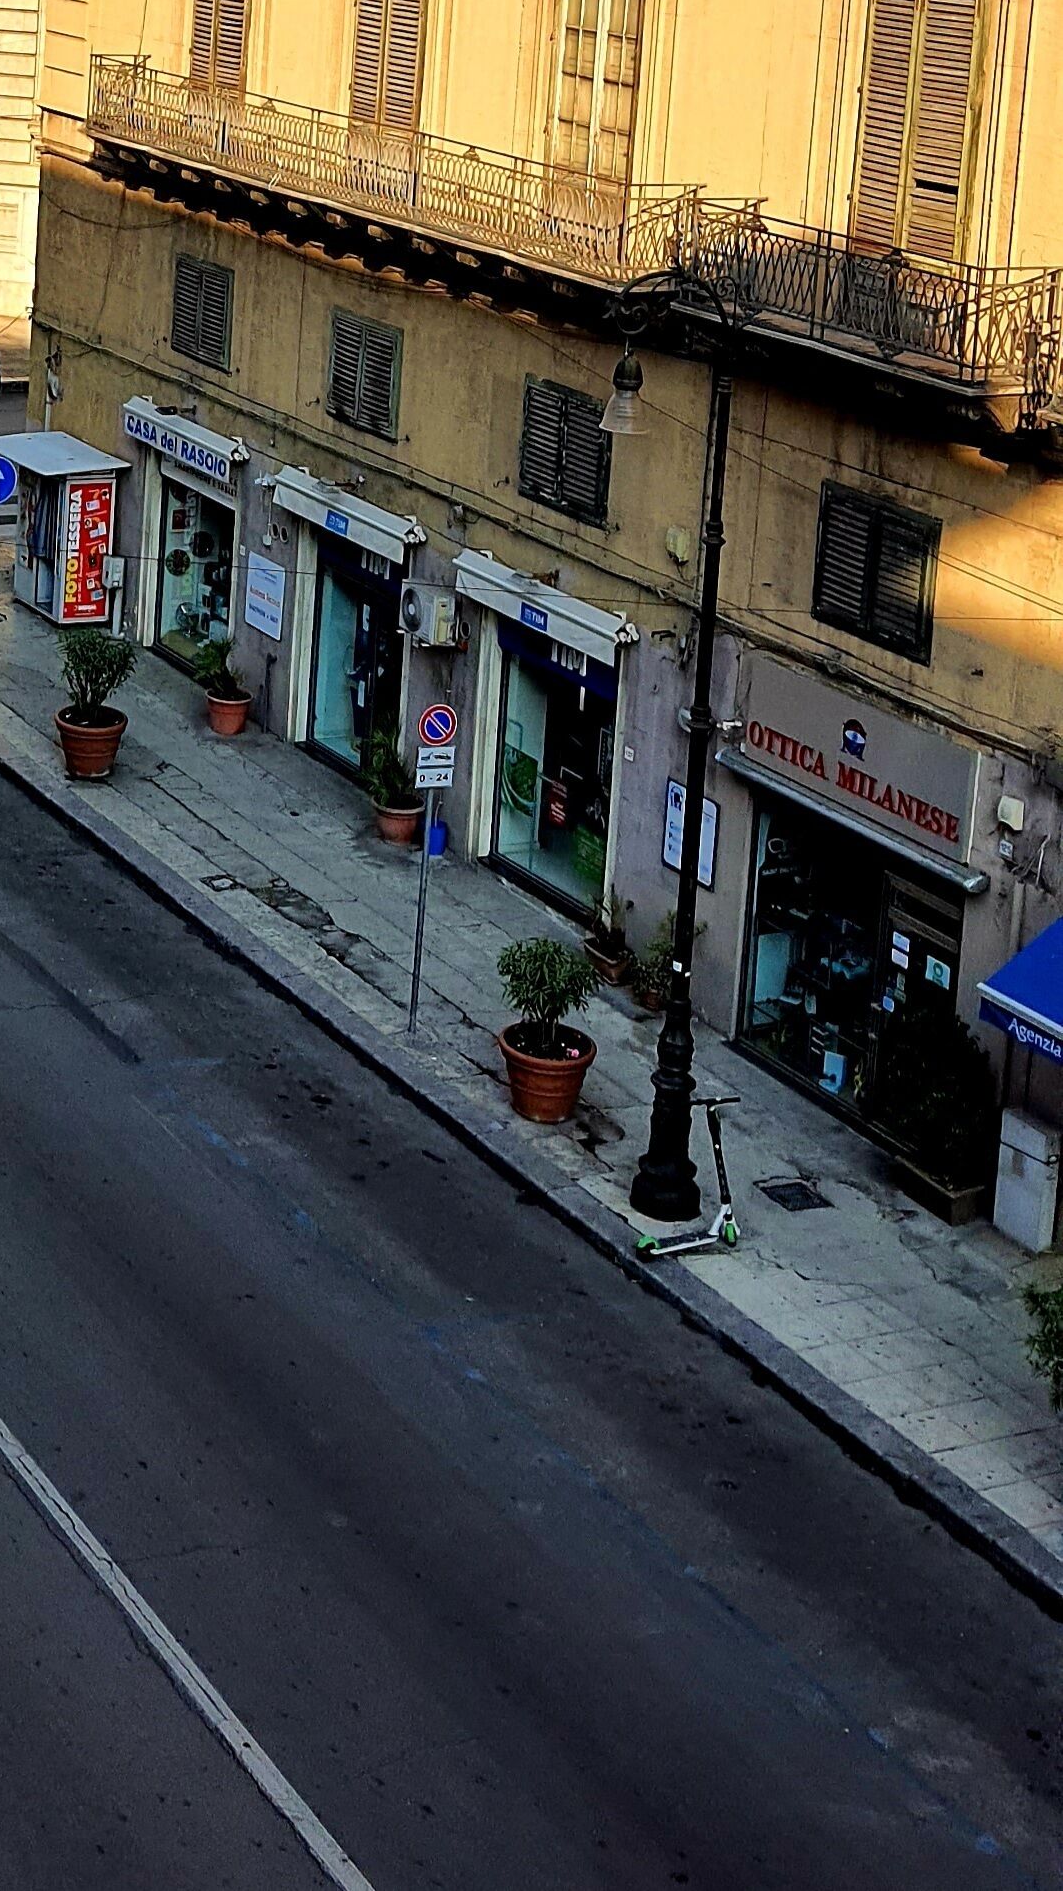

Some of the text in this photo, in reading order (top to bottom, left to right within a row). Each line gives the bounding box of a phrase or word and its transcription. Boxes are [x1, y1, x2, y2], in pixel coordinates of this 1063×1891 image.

[127, 415, 227, 478] CASA del RASOIO
[419, 774, 426, 783] 0
[436, 773, 449, 782] 24
[748, 720, 960, 843] OTTICA MILANESE
[1008, 1017, 1062, 1059] Agenzia
